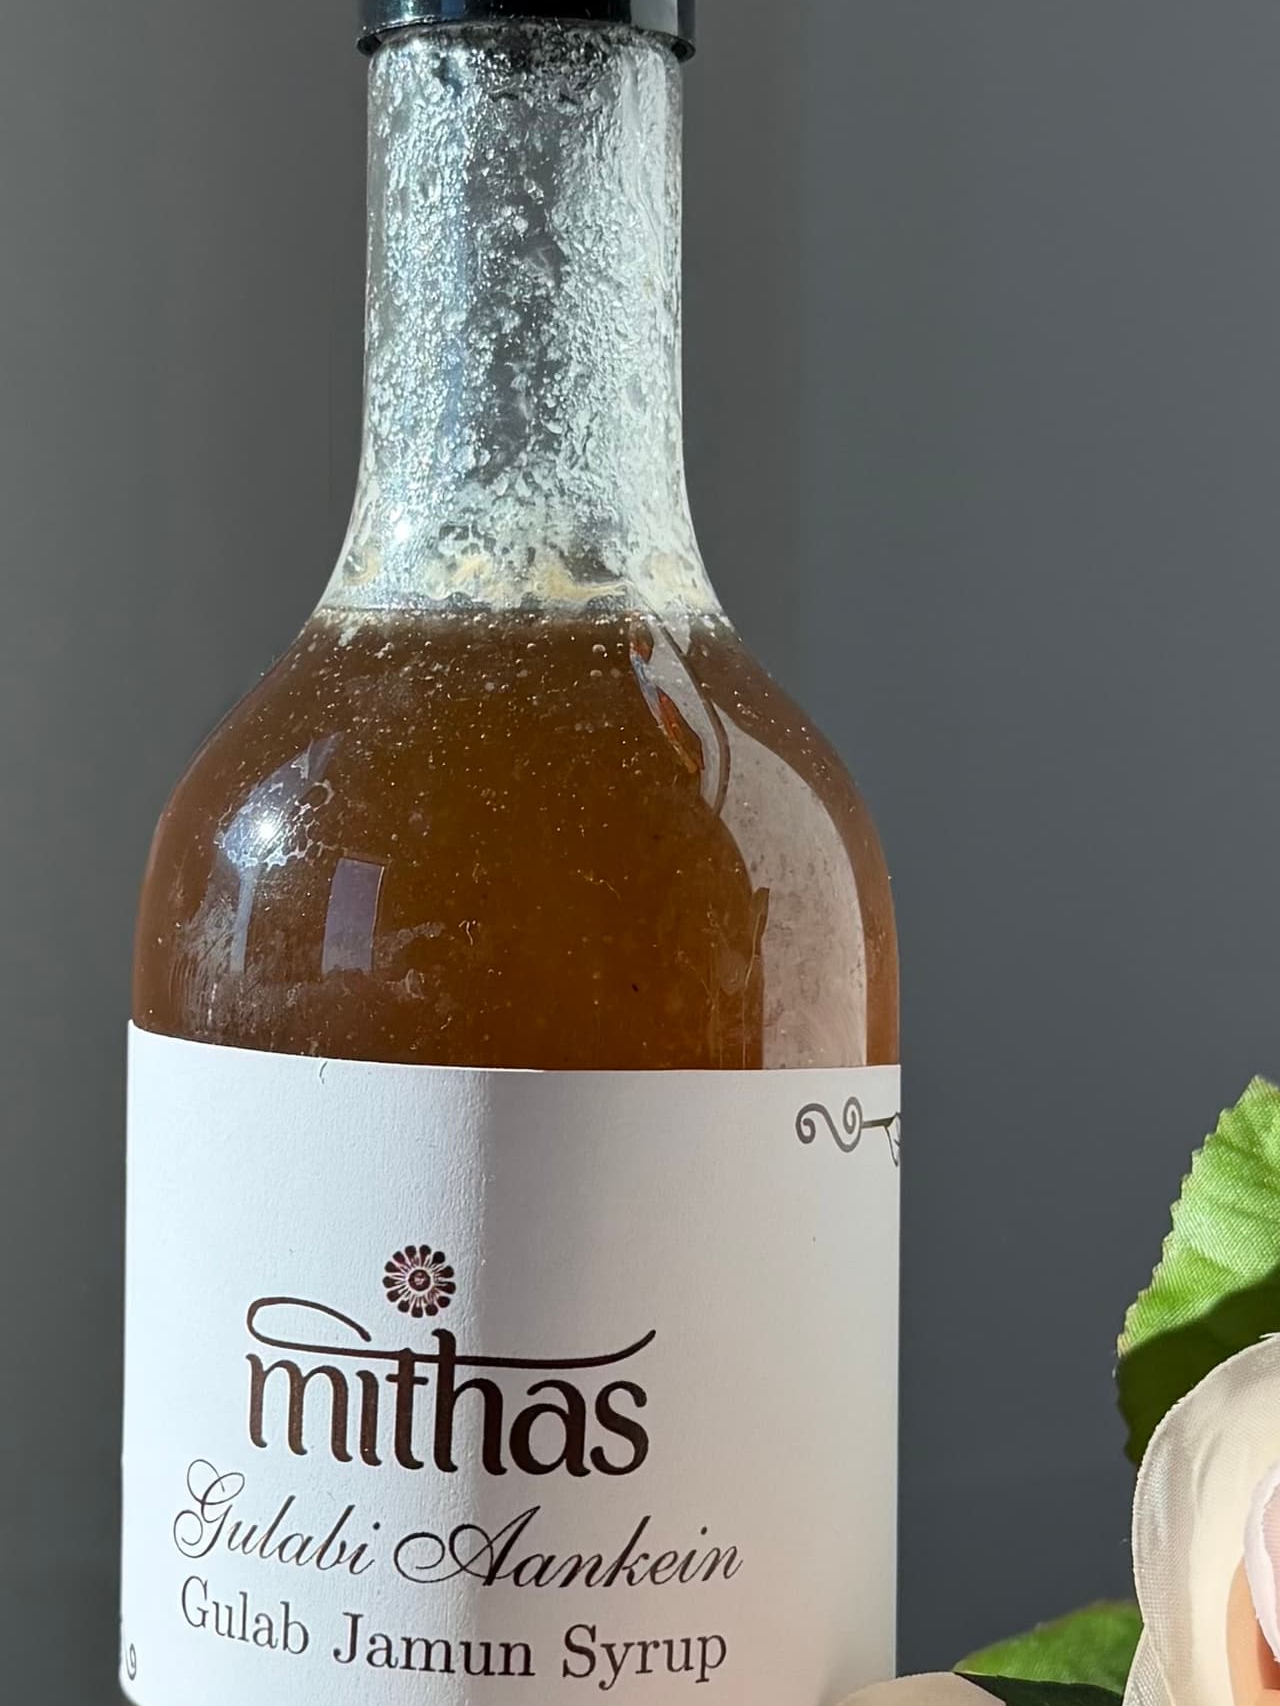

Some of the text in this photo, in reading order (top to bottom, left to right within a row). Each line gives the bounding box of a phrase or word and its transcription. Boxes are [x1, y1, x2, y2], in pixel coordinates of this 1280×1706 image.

[245, 1328, 650, 1478] mithas
[172, 1459, 744, 1591] Gulabi Aankein
[180, 1575, 729, 1691] Gulab Jamun Syrup
